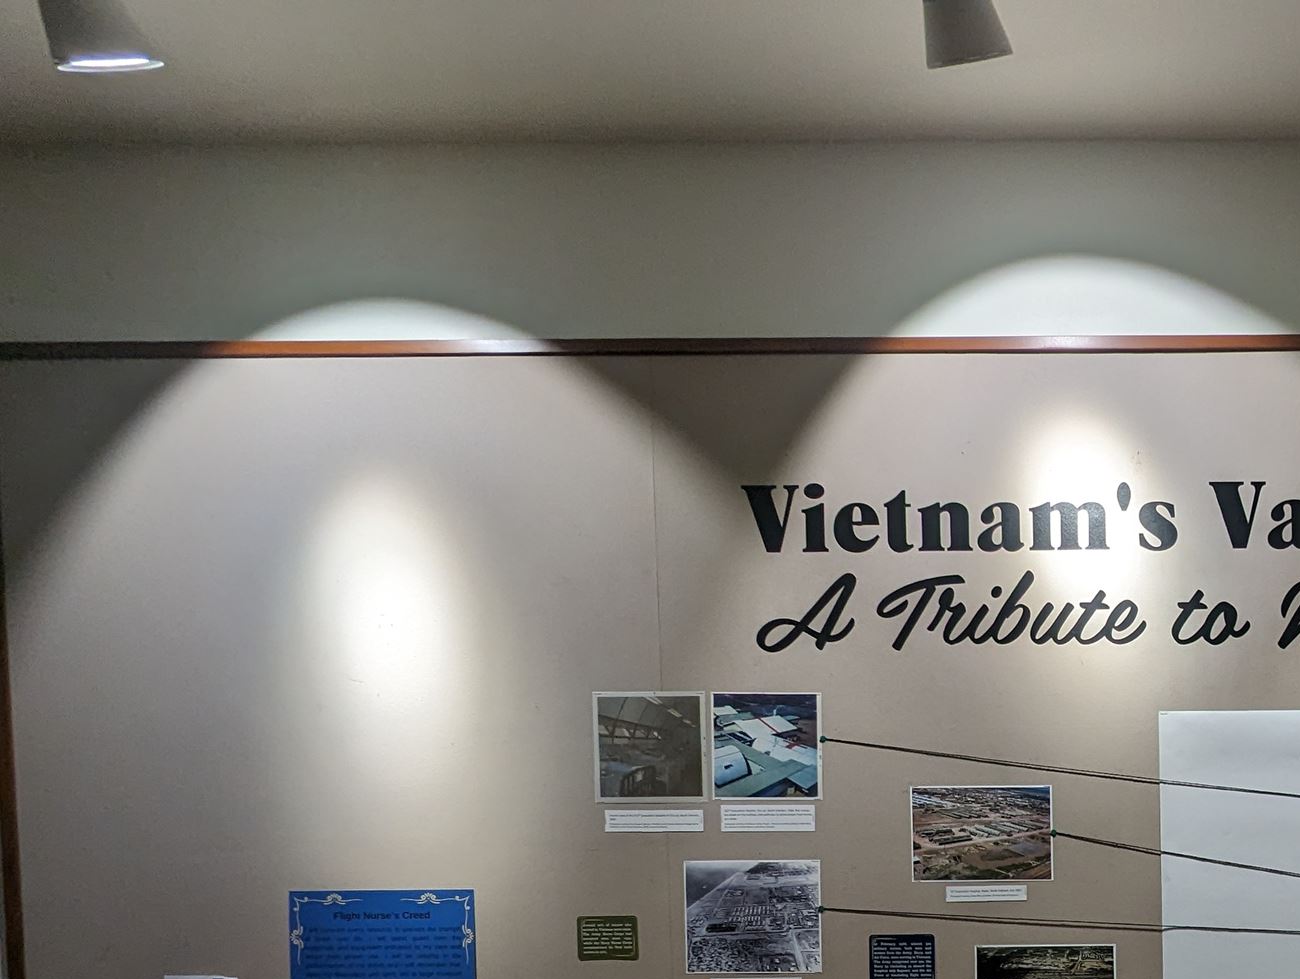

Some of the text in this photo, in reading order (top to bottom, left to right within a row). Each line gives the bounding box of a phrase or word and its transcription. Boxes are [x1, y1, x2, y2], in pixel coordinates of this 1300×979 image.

[741, 481, 1178, 553] Vietnam's
[756, 573, 857, 653] A
[876, 570, 1147, 652] Tribute
[1171, 589, 1251, 646] to
[333, 911, 361, 922] Flight
[401, 911, 431, 920] Creed
